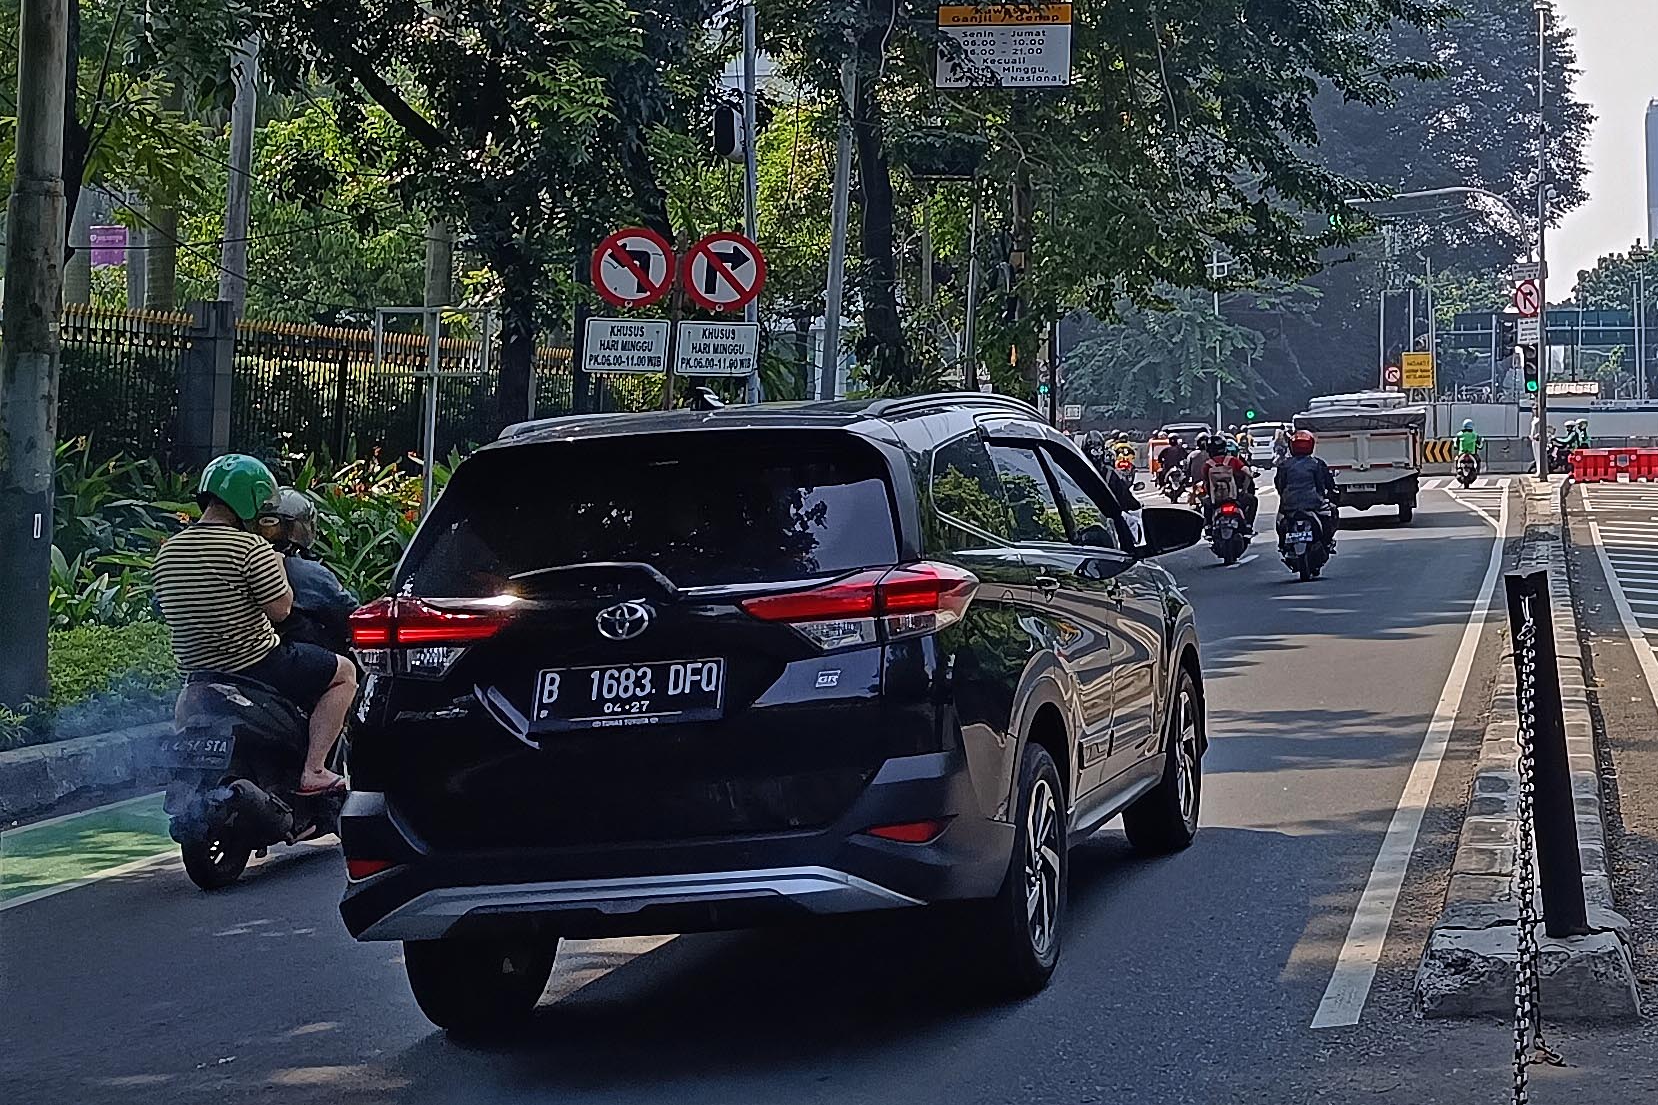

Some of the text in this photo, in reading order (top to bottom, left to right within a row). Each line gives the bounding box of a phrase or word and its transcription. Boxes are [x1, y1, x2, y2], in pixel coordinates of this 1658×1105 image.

[974, 7, 1040, 15] Kaws
[952, 16, 992, 24] Ganjil
[1016, 15, 1060, 23] Genap
[1011, 30, 1047, 38] Jumat
[962, 39, 996, 47] 06.00
[1013, 38, 1045, 46] 10.00
[1012, 48, 1043, 56] 21.00
[982, 57, 1027, 65] Kecuali
[610, 325, 645, 338] KHUSUS
[702, 328, 736, 341] KHUSUS
[599, 339, 654, 352] HARI MINGGU
[691, 342, 745, 356] HARI MINGGU
[647, 355, 662, 368] WIB
[543, 672, 561, 704] B
